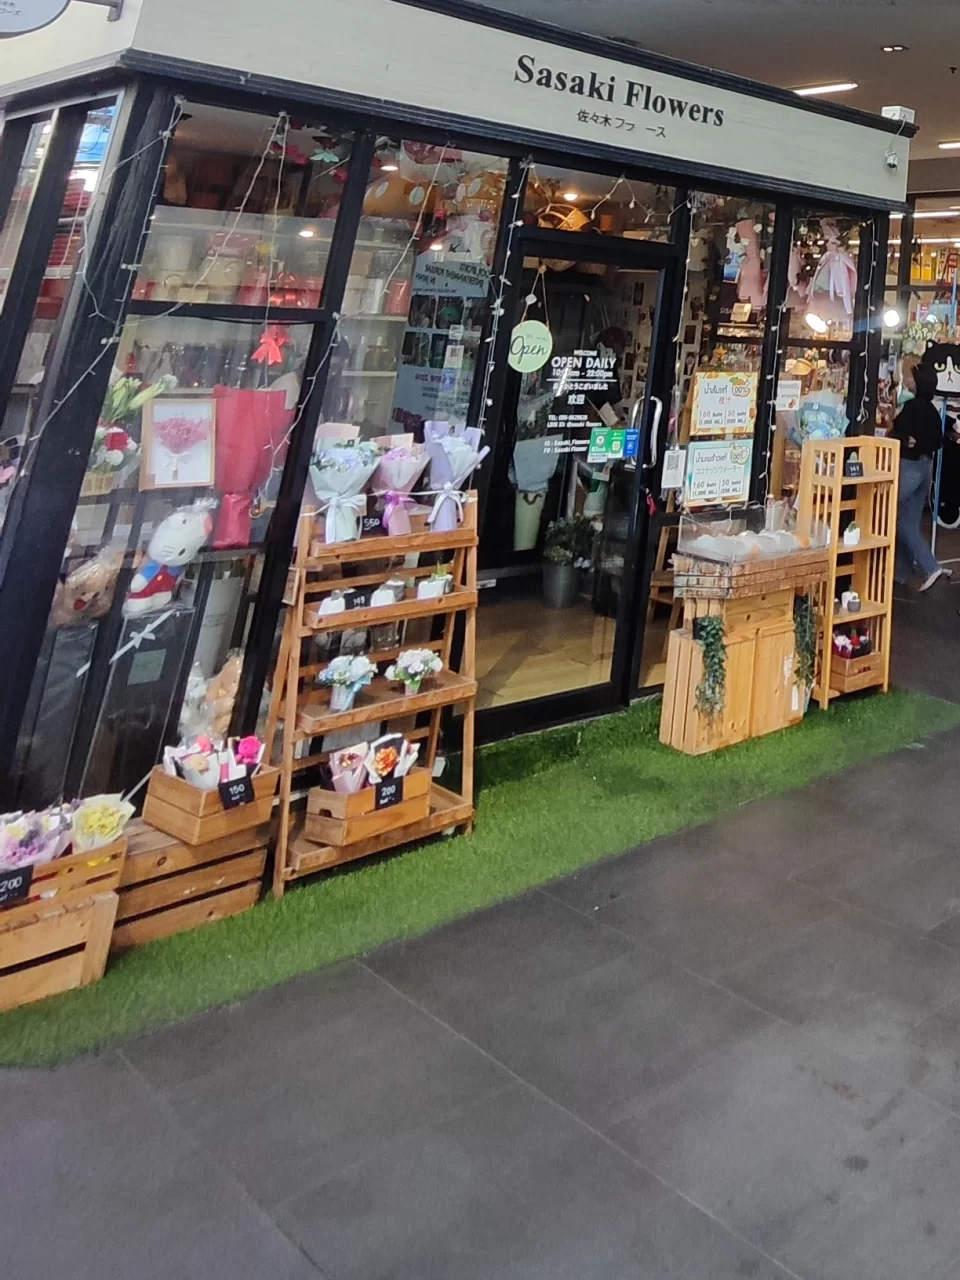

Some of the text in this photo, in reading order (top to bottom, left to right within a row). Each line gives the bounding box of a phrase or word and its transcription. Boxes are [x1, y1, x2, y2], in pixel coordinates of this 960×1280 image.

[514, 55, 725, 127] Sasaki Flowers
[510, 335, 548, 365] Open
[551, 356, 617, 369] OPEN DAILY
[229, 784, 245, 795] 150
[381, 785, 396, 797] 200
